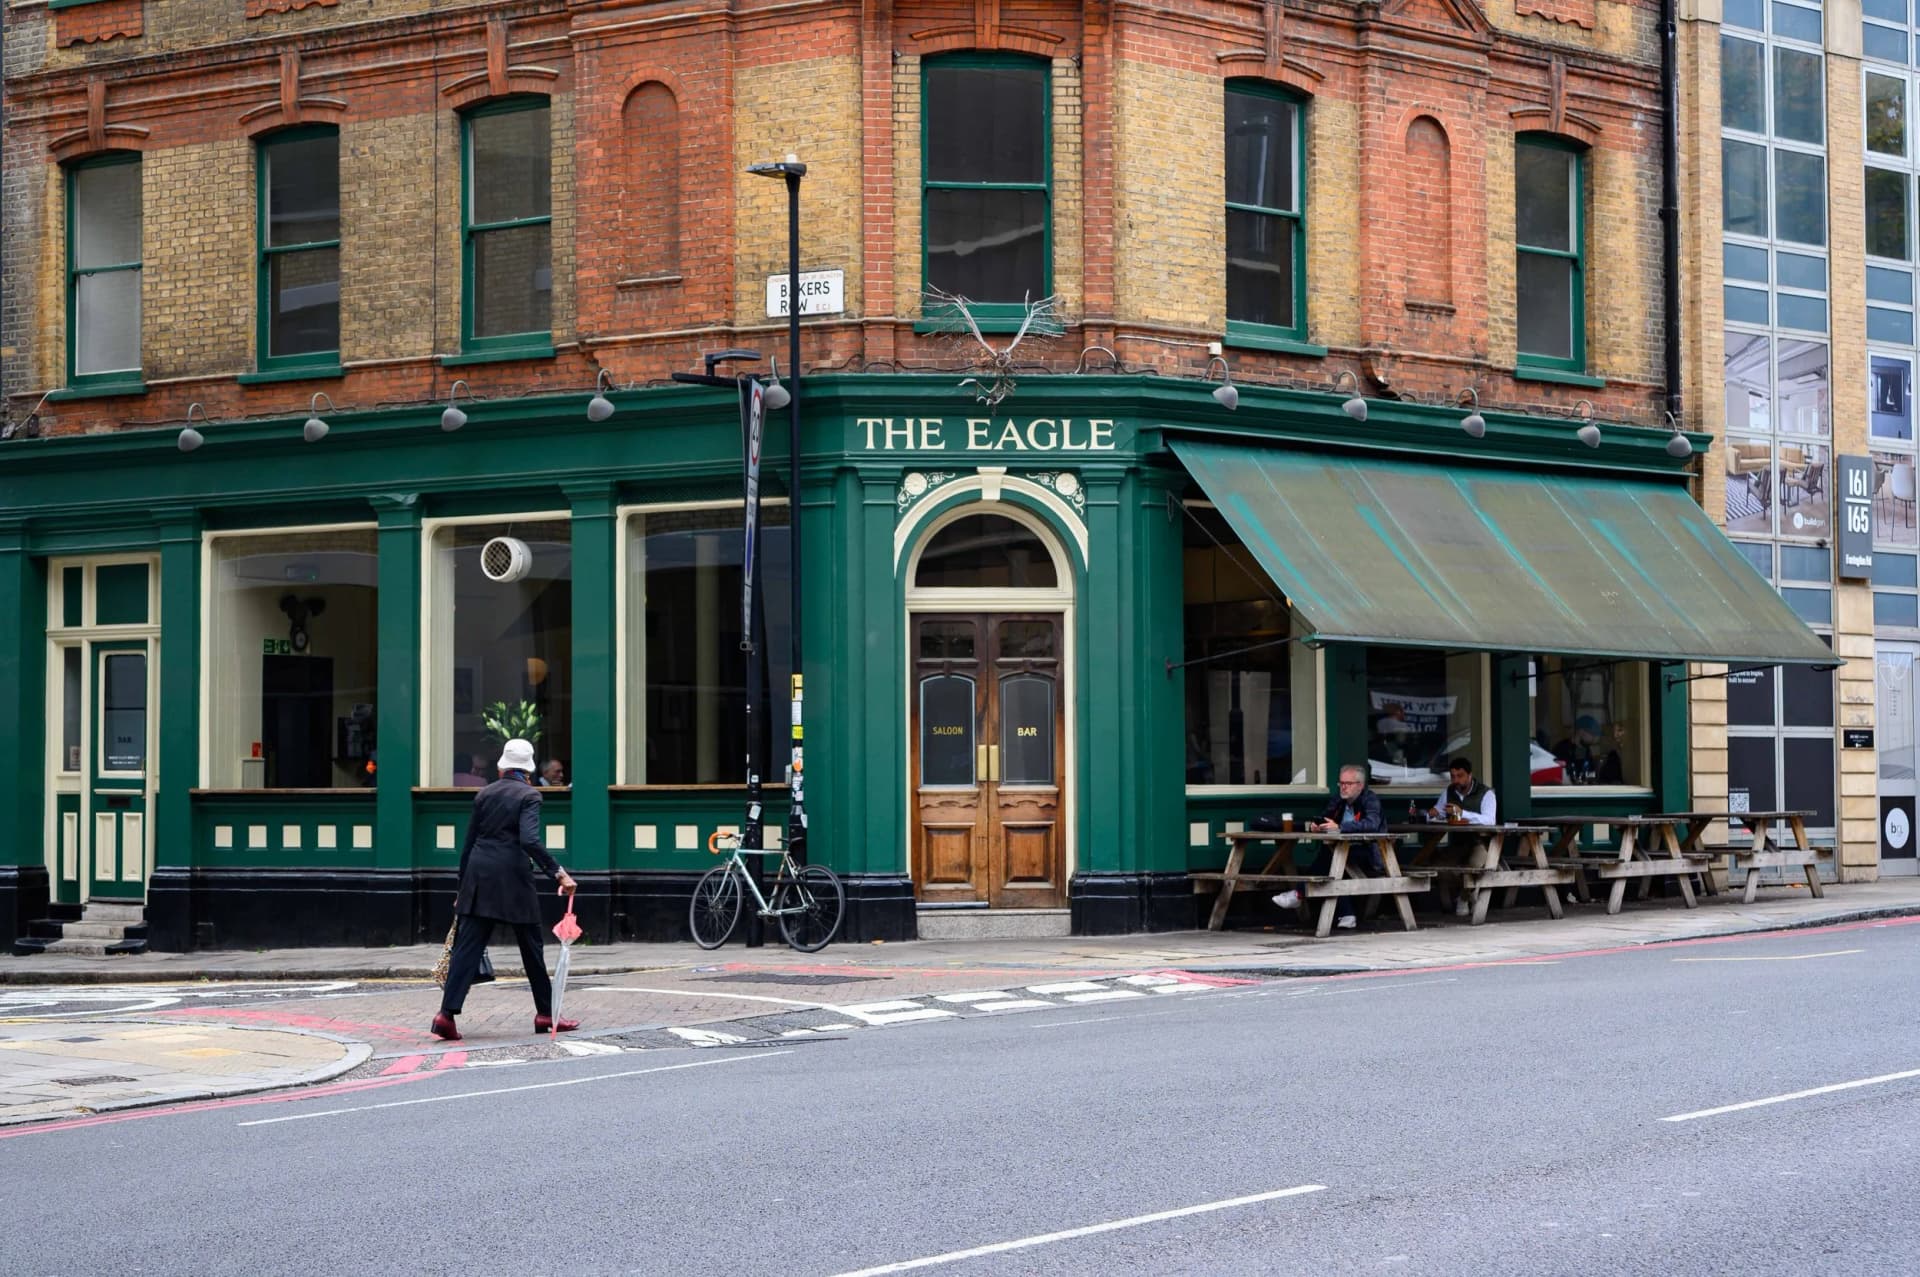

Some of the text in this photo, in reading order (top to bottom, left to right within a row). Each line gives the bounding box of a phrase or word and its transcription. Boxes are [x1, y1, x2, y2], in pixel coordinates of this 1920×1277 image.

[780, 281, 830, 298] BKERS
[780, 298, 808, 313] RW
[857, 418, 1116, 451] THE EAGLE
[1848, 468, 1868, 497] 161
[1847, 505, 1869, 534] 165
[932, 726, 1037, 737] SALOON BAR
